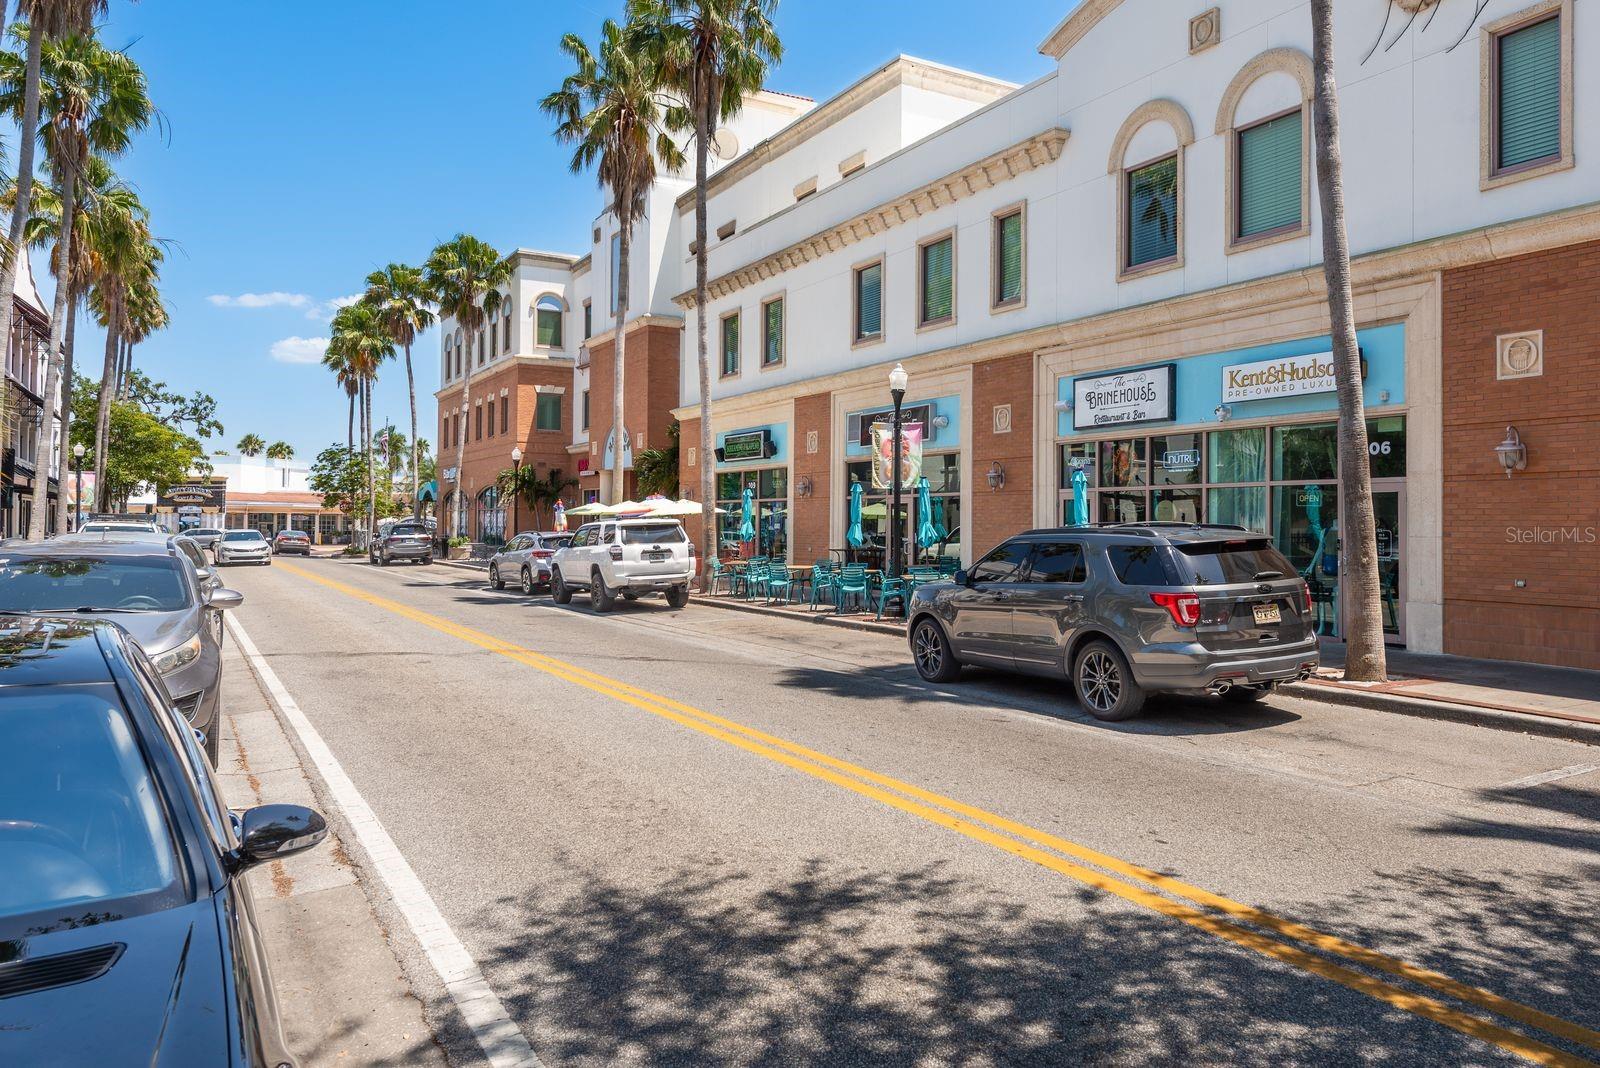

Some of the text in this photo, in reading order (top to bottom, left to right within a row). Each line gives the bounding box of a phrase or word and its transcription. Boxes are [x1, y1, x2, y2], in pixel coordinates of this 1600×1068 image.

[1228, 358, 1335, 389] Kent&Hudso
[1112, 375, 1126, 389] The
[1228, 379, 1337, 398] PRE-OWNED LUXU
[1085, 382, 1157, 410] BRINEHOUSE
[1093, 413, 1127, 425] Restaurant
[1132, 409, 1146, 421] Bar
[1369, 440, 1391, 456] 06
[1299, 494, 1320, 503] OPEN
